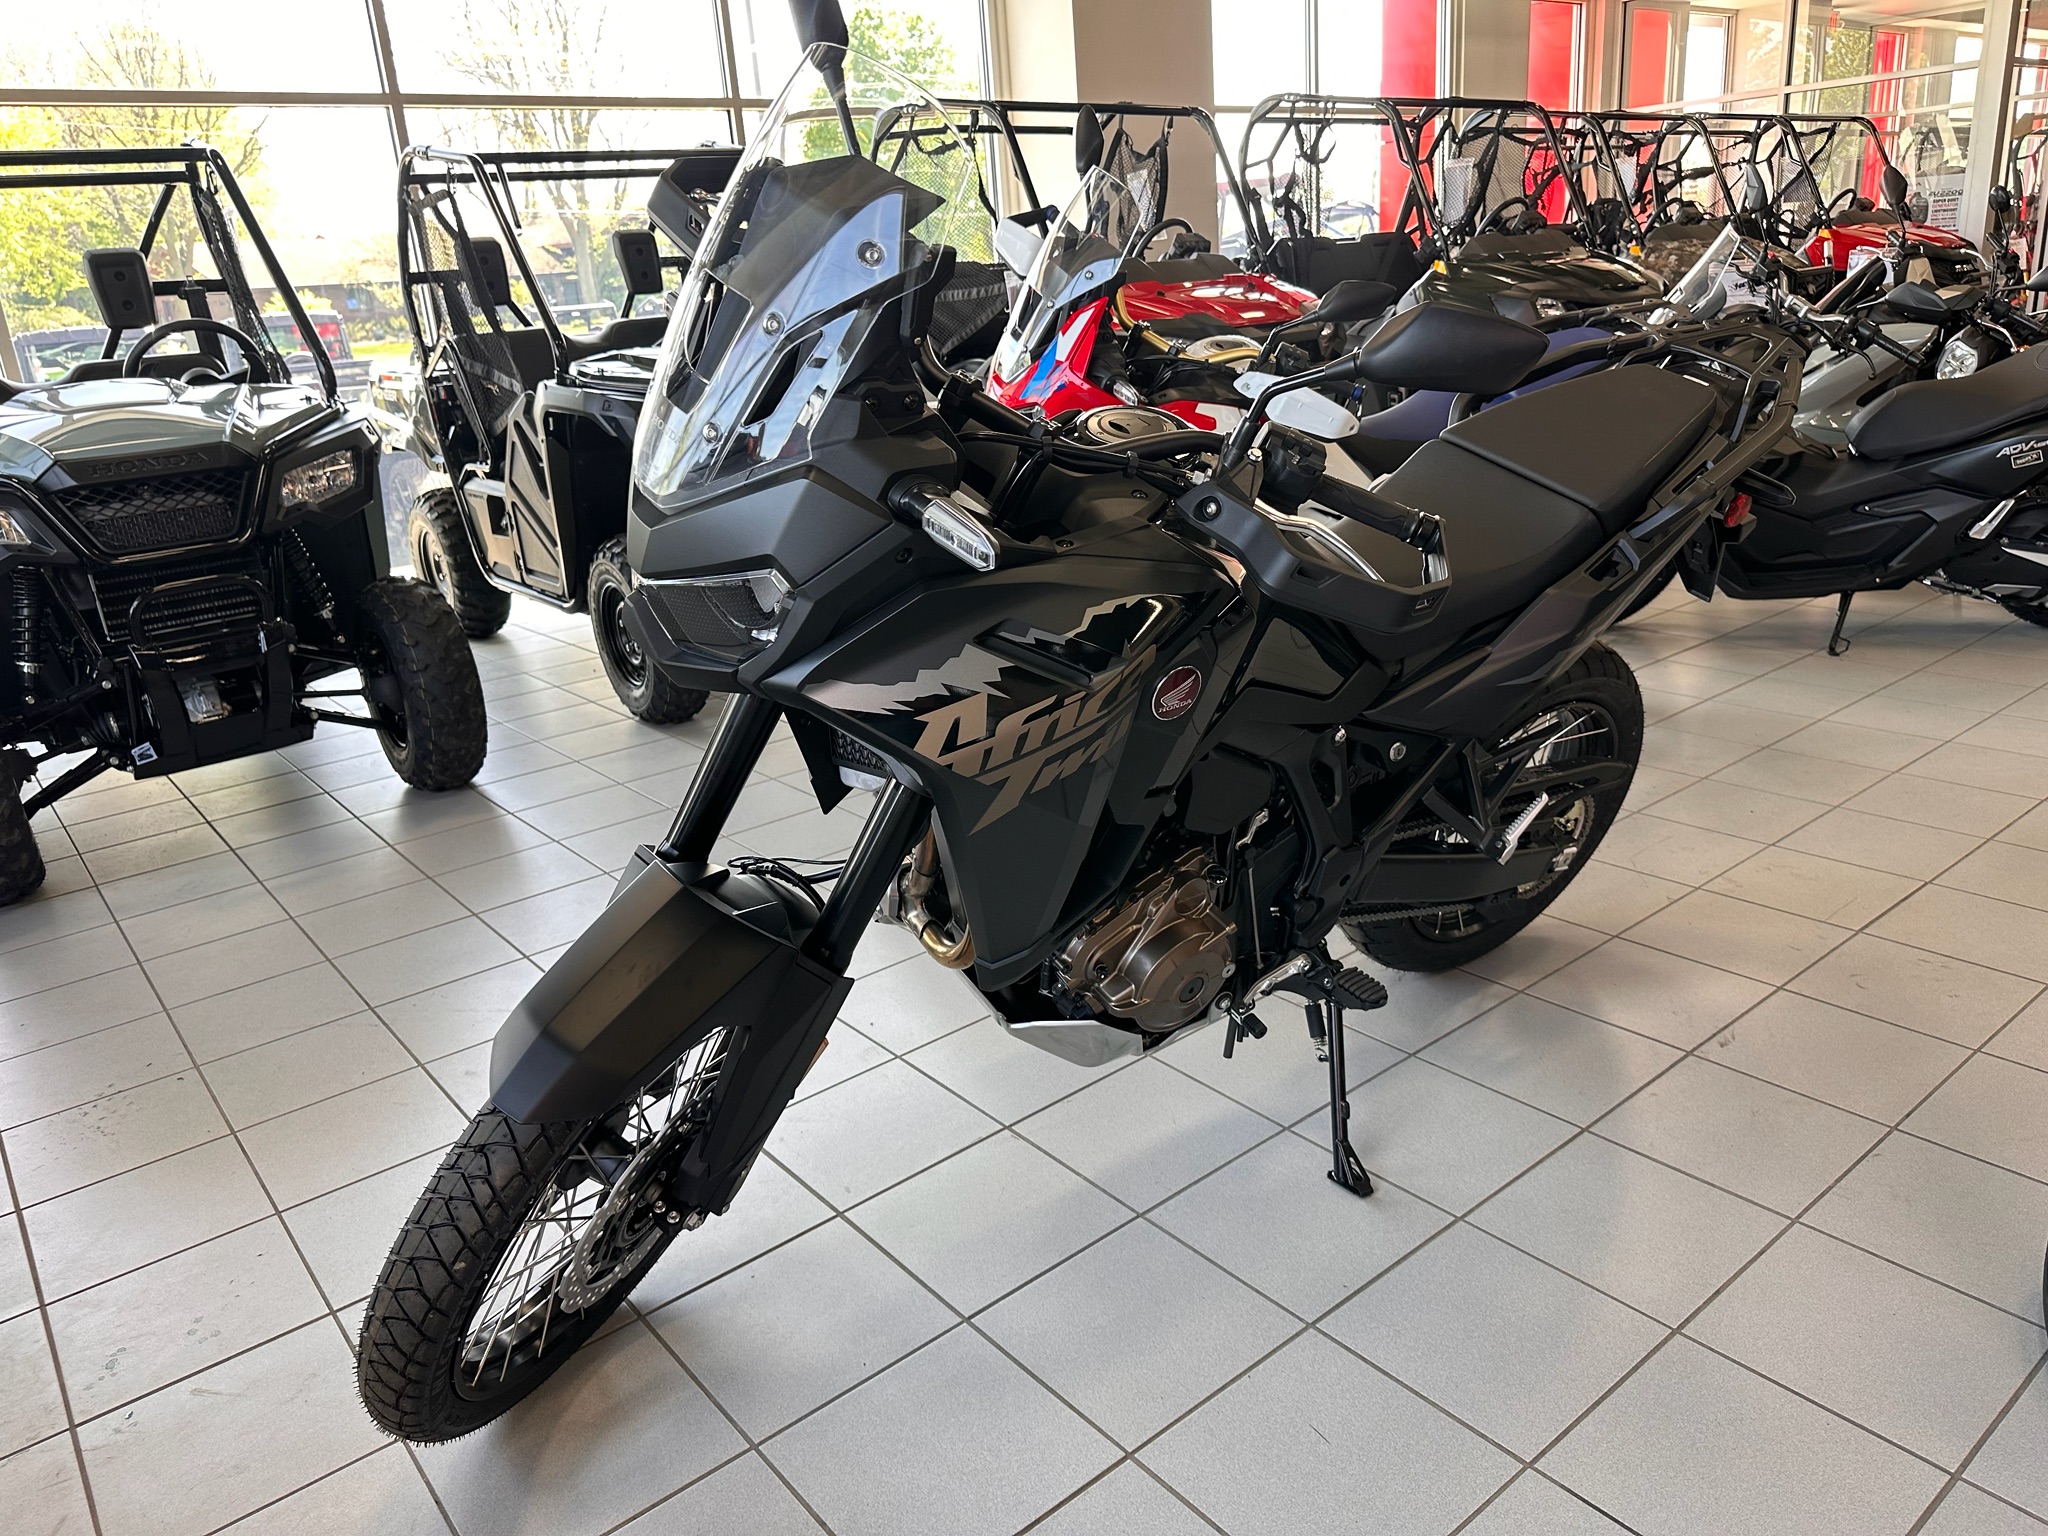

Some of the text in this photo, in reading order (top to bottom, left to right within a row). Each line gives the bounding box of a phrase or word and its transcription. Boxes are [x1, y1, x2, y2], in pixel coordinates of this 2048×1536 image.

[88, 451, 209, 477] HONDA
[913, 643, 1156, 777] Africa
[1158, 699, 1192, 713] HONDA
